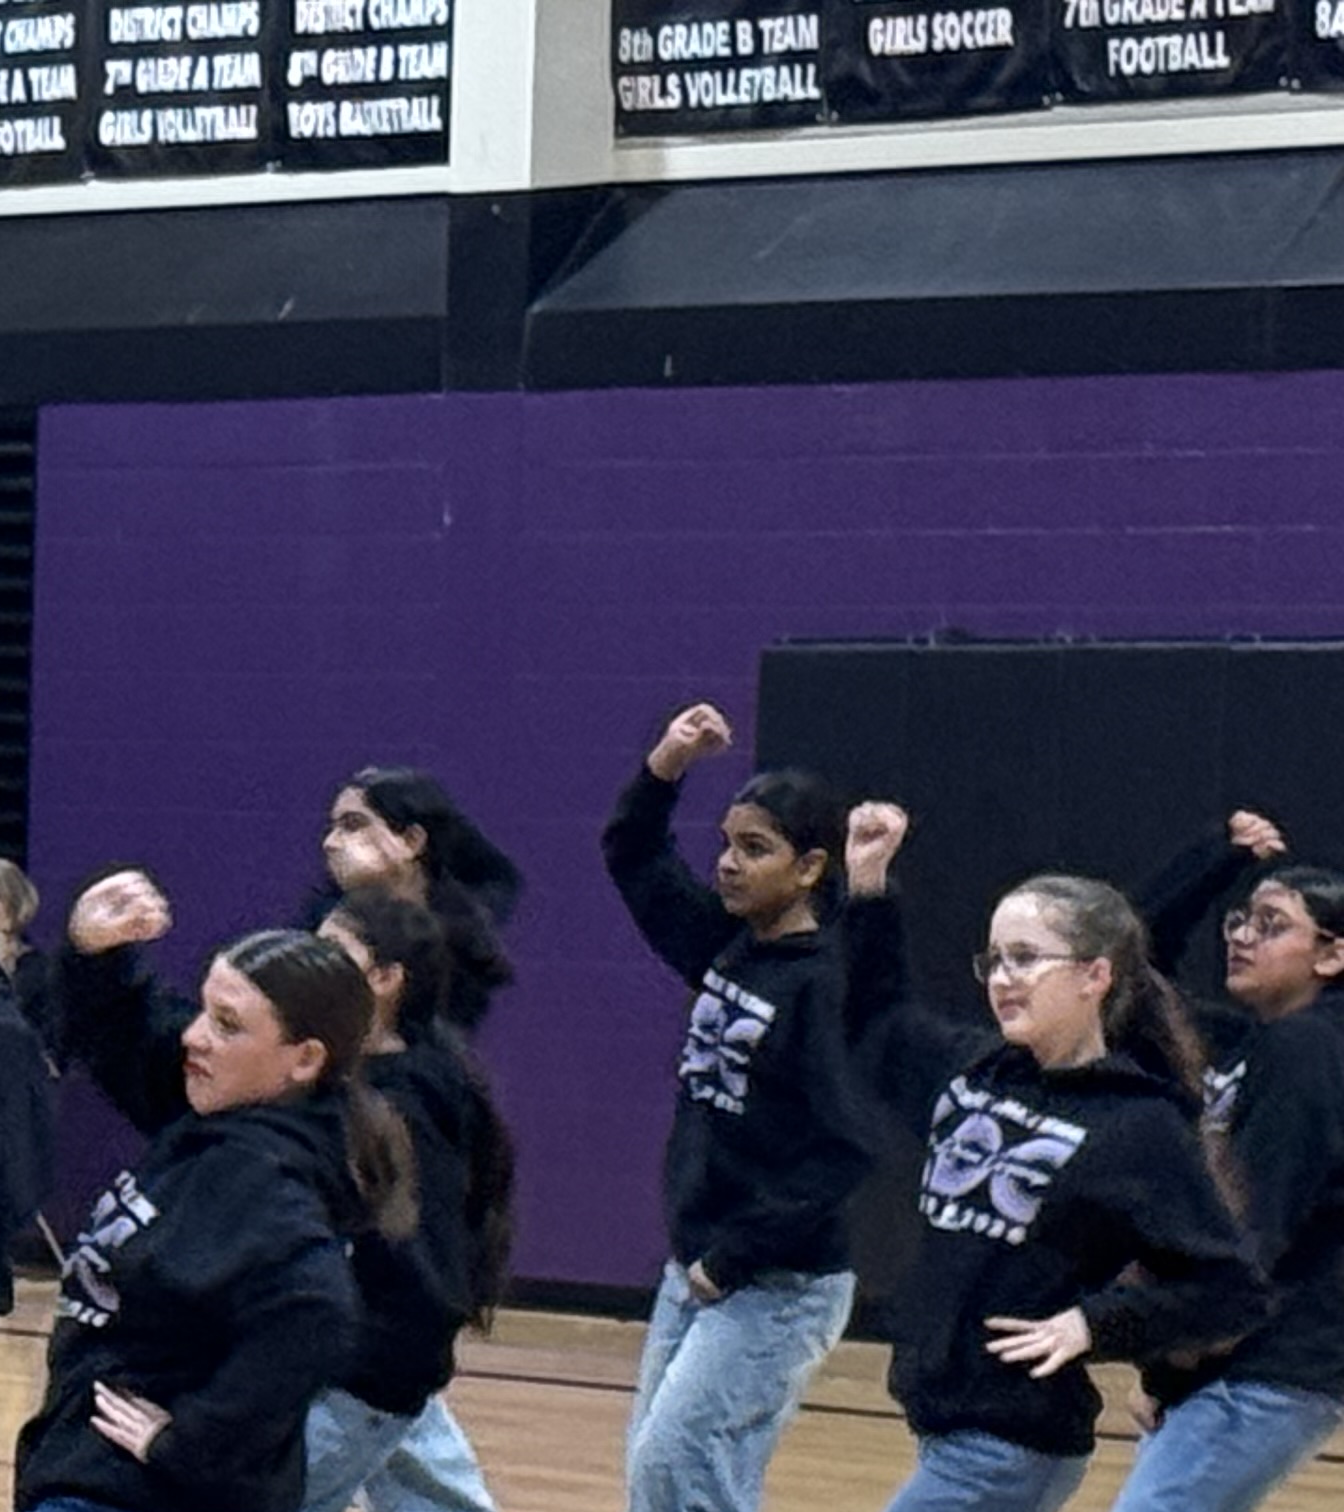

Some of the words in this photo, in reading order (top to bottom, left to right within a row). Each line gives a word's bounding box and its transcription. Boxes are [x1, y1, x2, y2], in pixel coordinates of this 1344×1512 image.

[4, 13, 76, 54] CHAMPS
[109, 5, 183, 43] DISTRICT
[186, 0, 260, 40] CHAMPS
[294, 0, 364, 34] DISTRICT
[368, 0, 449, 30] CHAMPS
[869, 14, 928, 56] GIRLS
[932, 7, 1014, 52] SOCCER
[618, 28, 653, 64] 8th
[658, 21, 732, 61] GRADE
[736, 19, 754, 55] B
[758, 14, 819, 54] TEAM
[1108, 31, 1230, 77] FOOTBALL
[11, 68, 27, 104] A
[28, 64, 77, 102] TEAM
[135, 55, 192, 94] GRADE
[192, 55, 209, 91] A
[212, 52, 262, 91] TEAM
[321, 46, 378, 85] GRADE
[398, 41, 448, 80] TEAM
[618, 73, 681, 110] GIRLS
[684, 63, 820, 108] VOLLEYBALL
[98, 109, 153, 147] GIRLS
[156, 104, 258, 144] VOLLEYBALL
[339, 95, 443, 137] BASKETBALL
